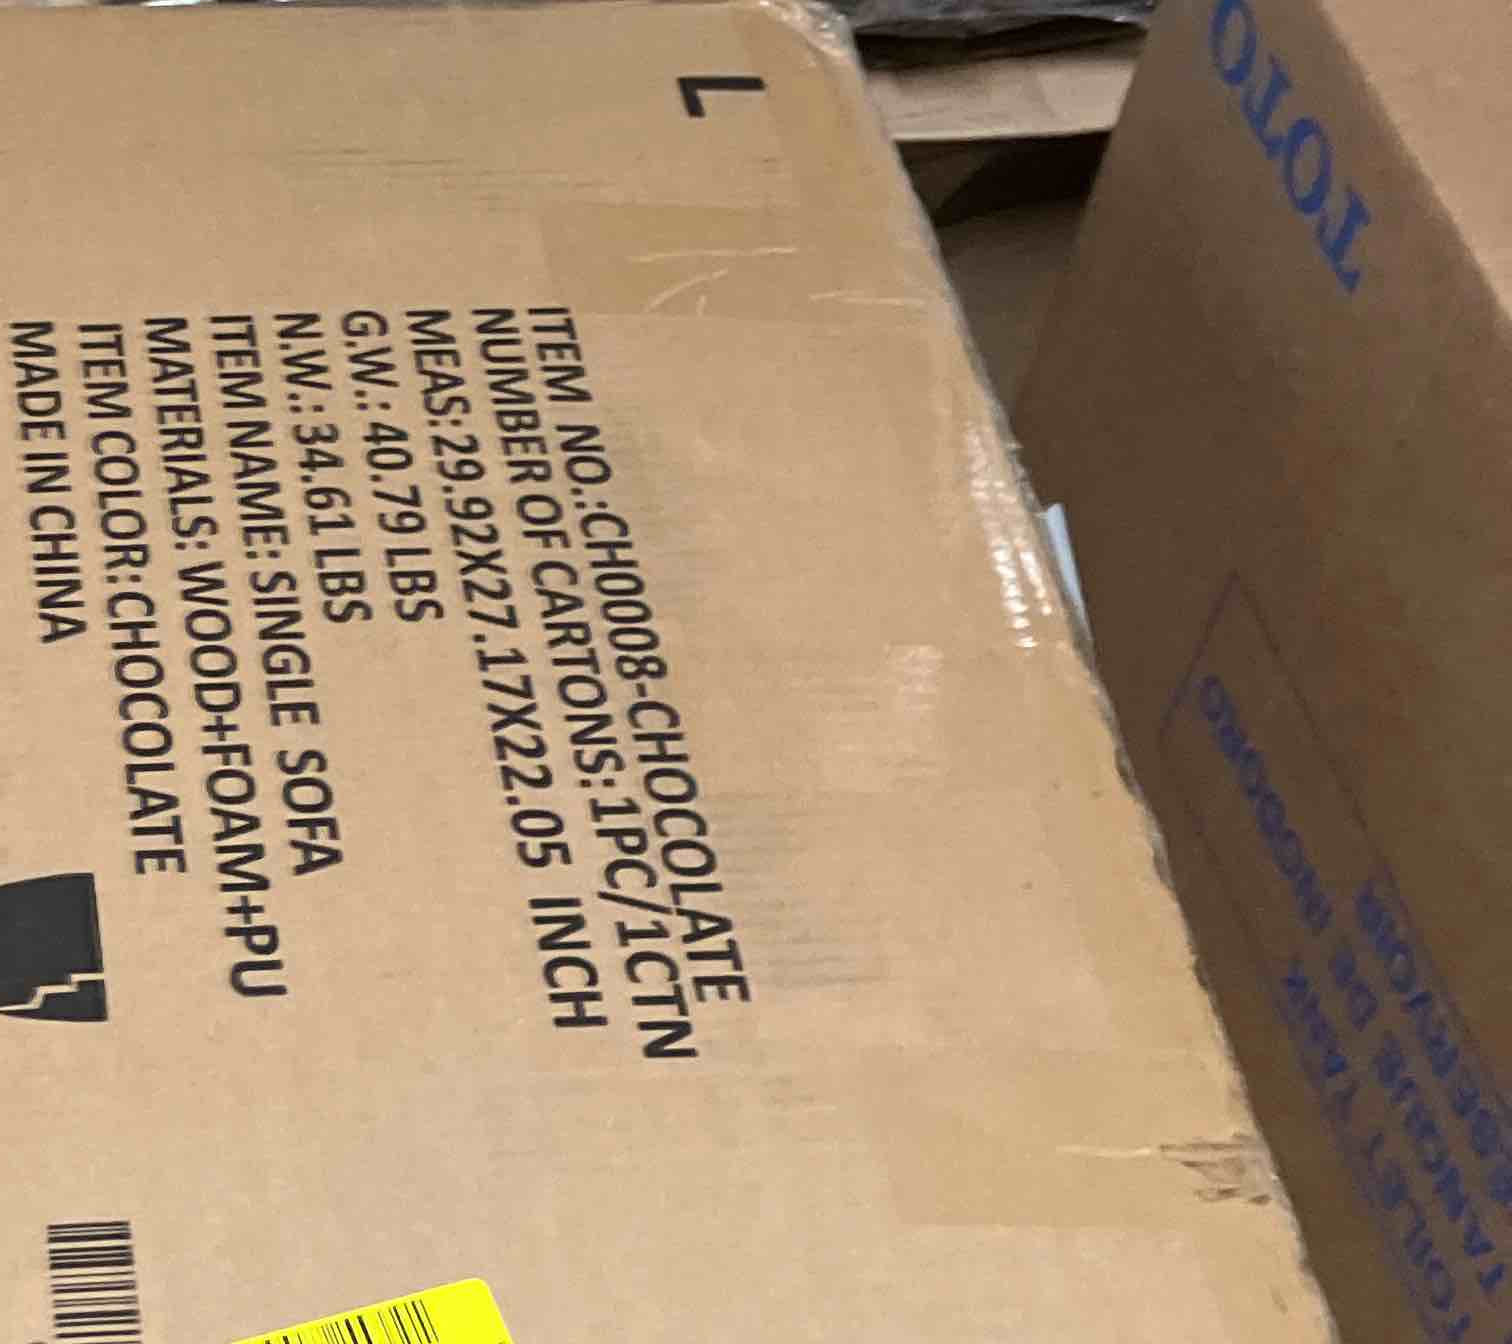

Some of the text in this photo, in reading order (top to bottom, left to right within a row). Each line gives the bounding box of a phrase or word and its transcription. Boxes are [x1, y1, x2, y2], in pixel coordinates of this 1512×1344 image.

[10, 321, 88, 645] MADE IN CHINA
[274, 312, 372, 624] N.W.: 34.61 LBS
[341, 310, 444, 623] G.W.: 40.79 LBS
[527, 305, 593, 405] ITEM
[77, 322, 188, 876] ITEM COLOR:CHOCOLATE
[144, 317, 287, 999] MATERIALS: WOOD+FOAM+PU
[209, 314, 344, 878] ITEM NAME: SINGLE SOFA
[471, 307, 699, 1059] NUMBER OF CARTONS:1PC/1CTN
[529, 896, 608, 1029] INCH
